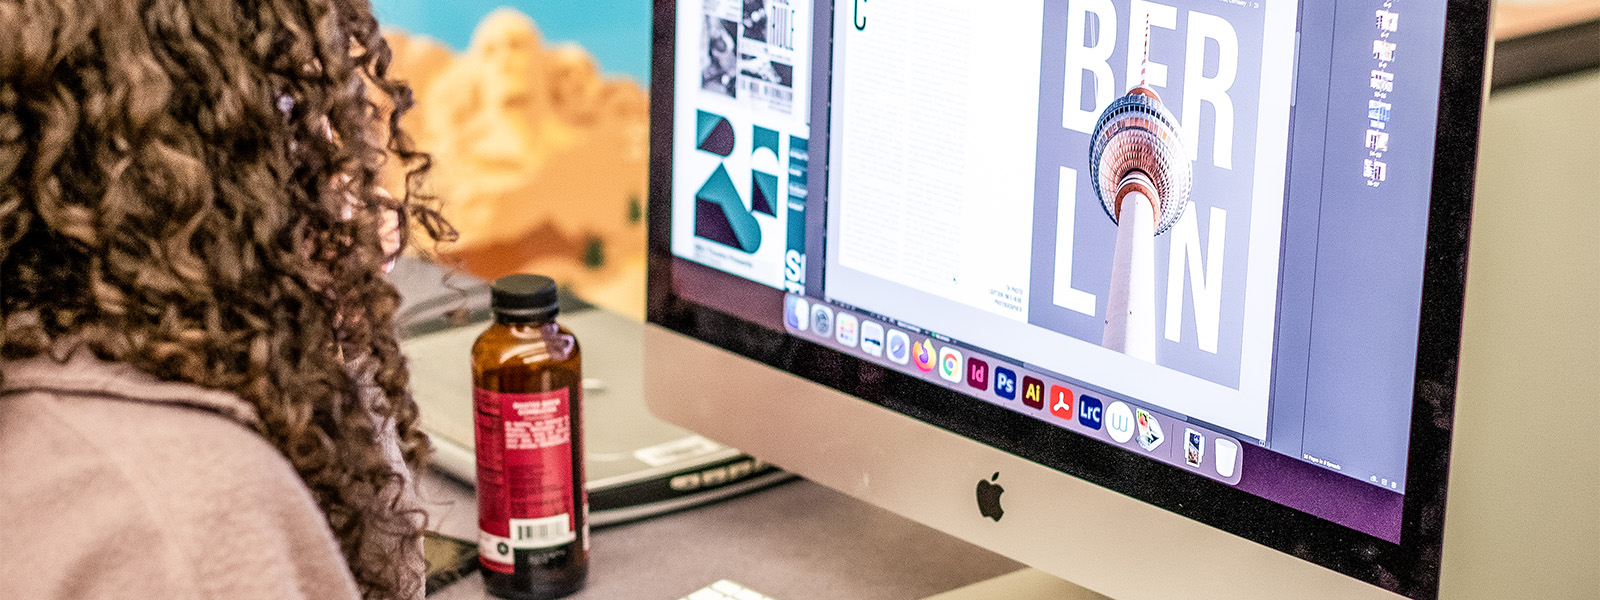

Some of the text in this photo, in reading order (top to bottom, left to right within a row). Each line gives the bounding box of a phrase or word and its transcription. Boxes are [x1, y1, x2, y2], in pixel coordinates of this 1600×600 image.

[1062, 0, 1238, 171] BER
[1053, 165, 1227, 354] LN
[972, 364, 985, 383] Id
[997, 372, 1014, 393] Ps
[1025, 383, 1041, 402] Ai
[1080, 401, 1101, 423] LrC
